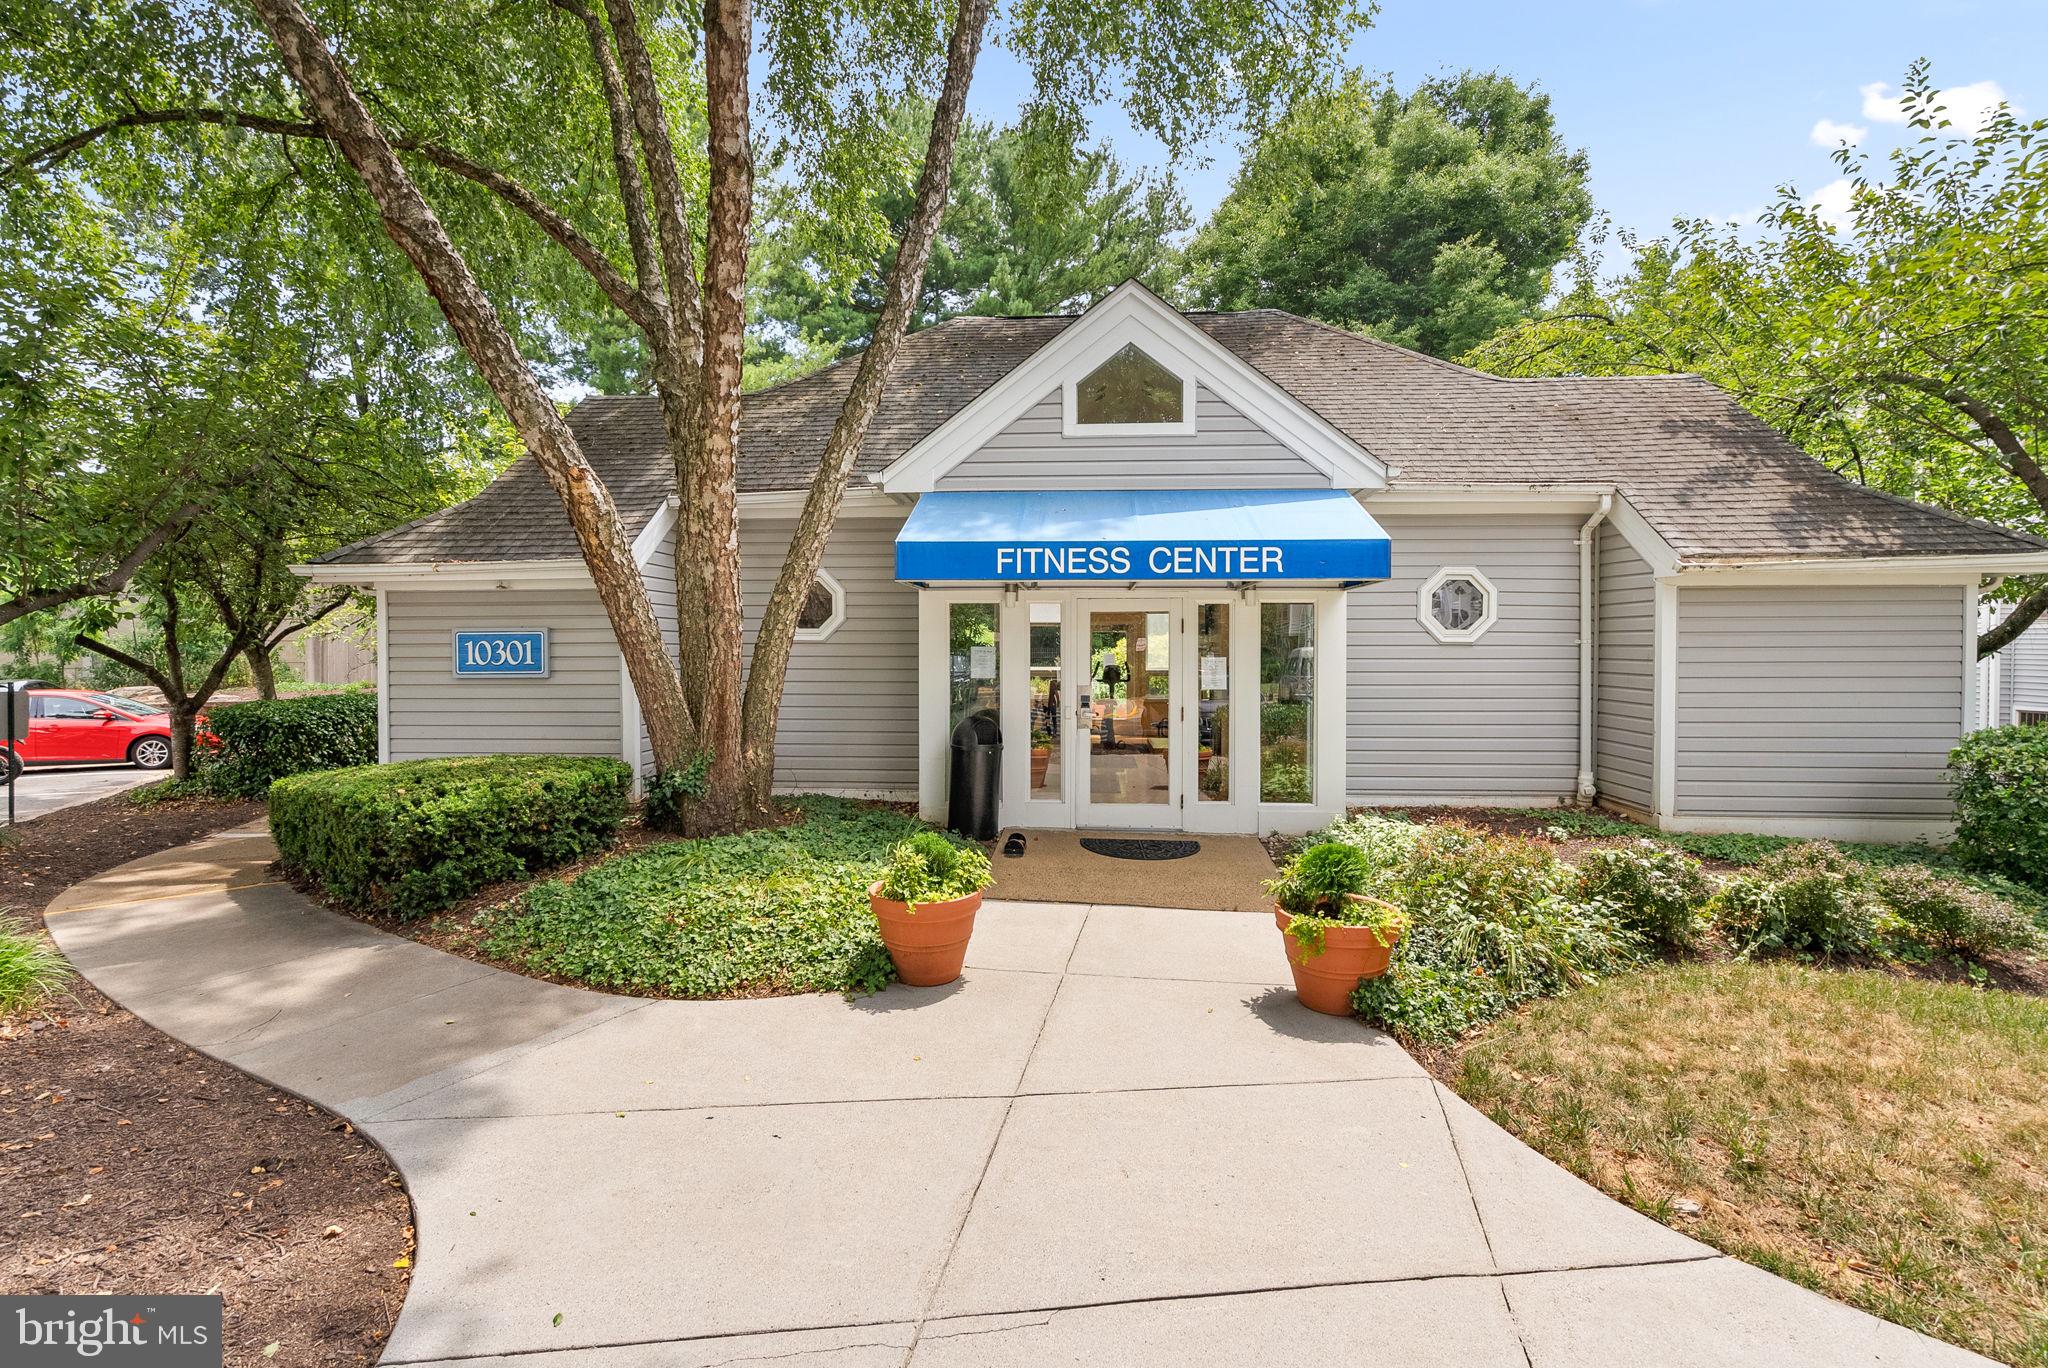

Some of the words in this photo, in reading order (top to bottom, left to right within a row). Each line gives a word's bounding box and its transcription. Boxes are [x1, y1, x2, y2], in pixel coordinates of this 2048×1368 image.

[997, 547, 1131, 574] FITNESS
[1148, 546, 1284, 574] CENTER
[464, 640, 535, 666] 10301
